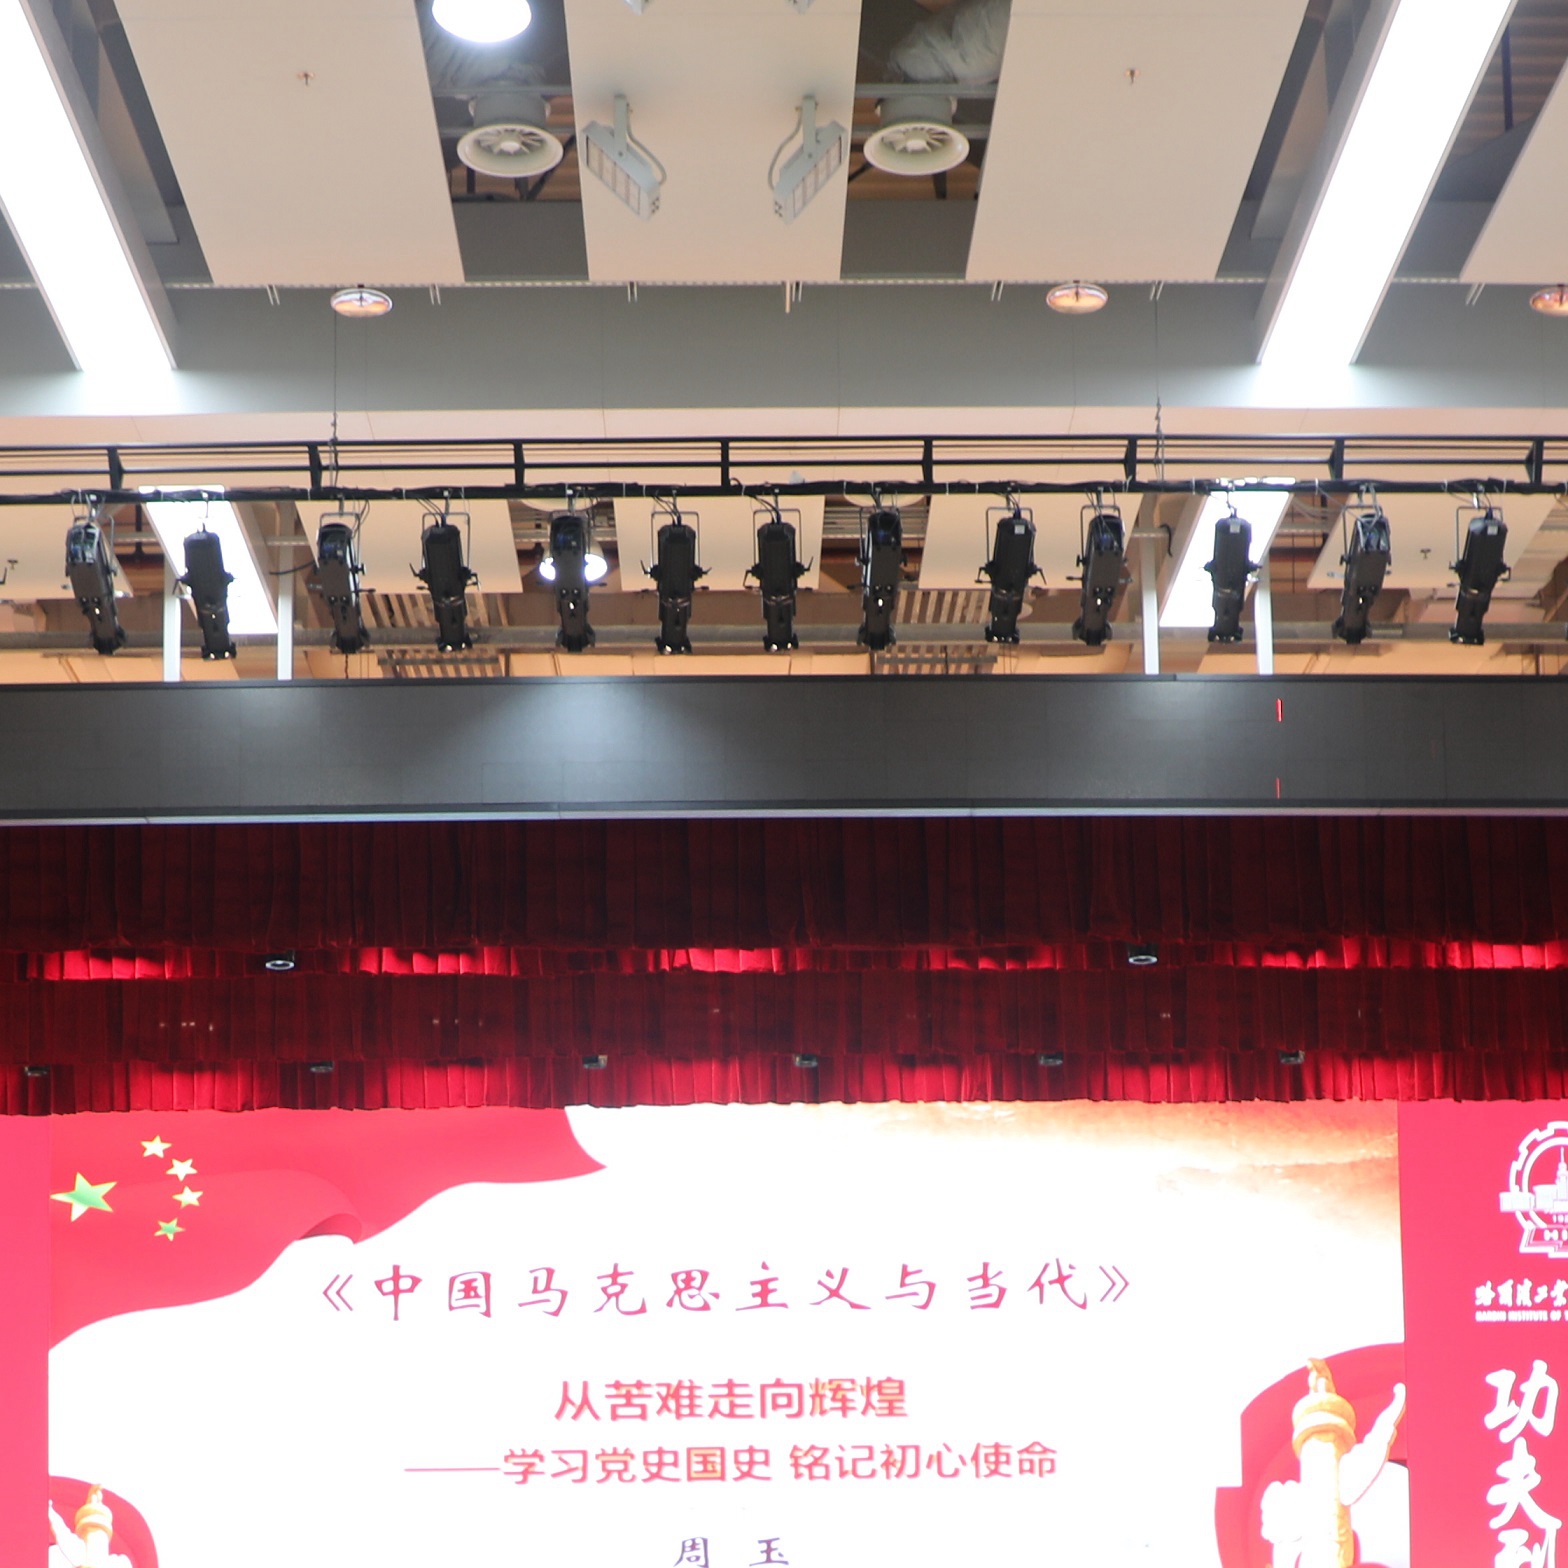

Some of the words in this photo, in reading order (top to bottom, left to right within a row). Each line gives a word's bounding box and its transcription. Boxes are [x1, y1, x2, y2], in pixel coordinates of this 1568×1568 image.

[322, 1258, 1130, 1321] 《中国马克思主义与当代》
[553, 1376, 909, 1422] 从苦难走向辉煌
[788, 1440, 1059, 1482] 铭记初心使命
